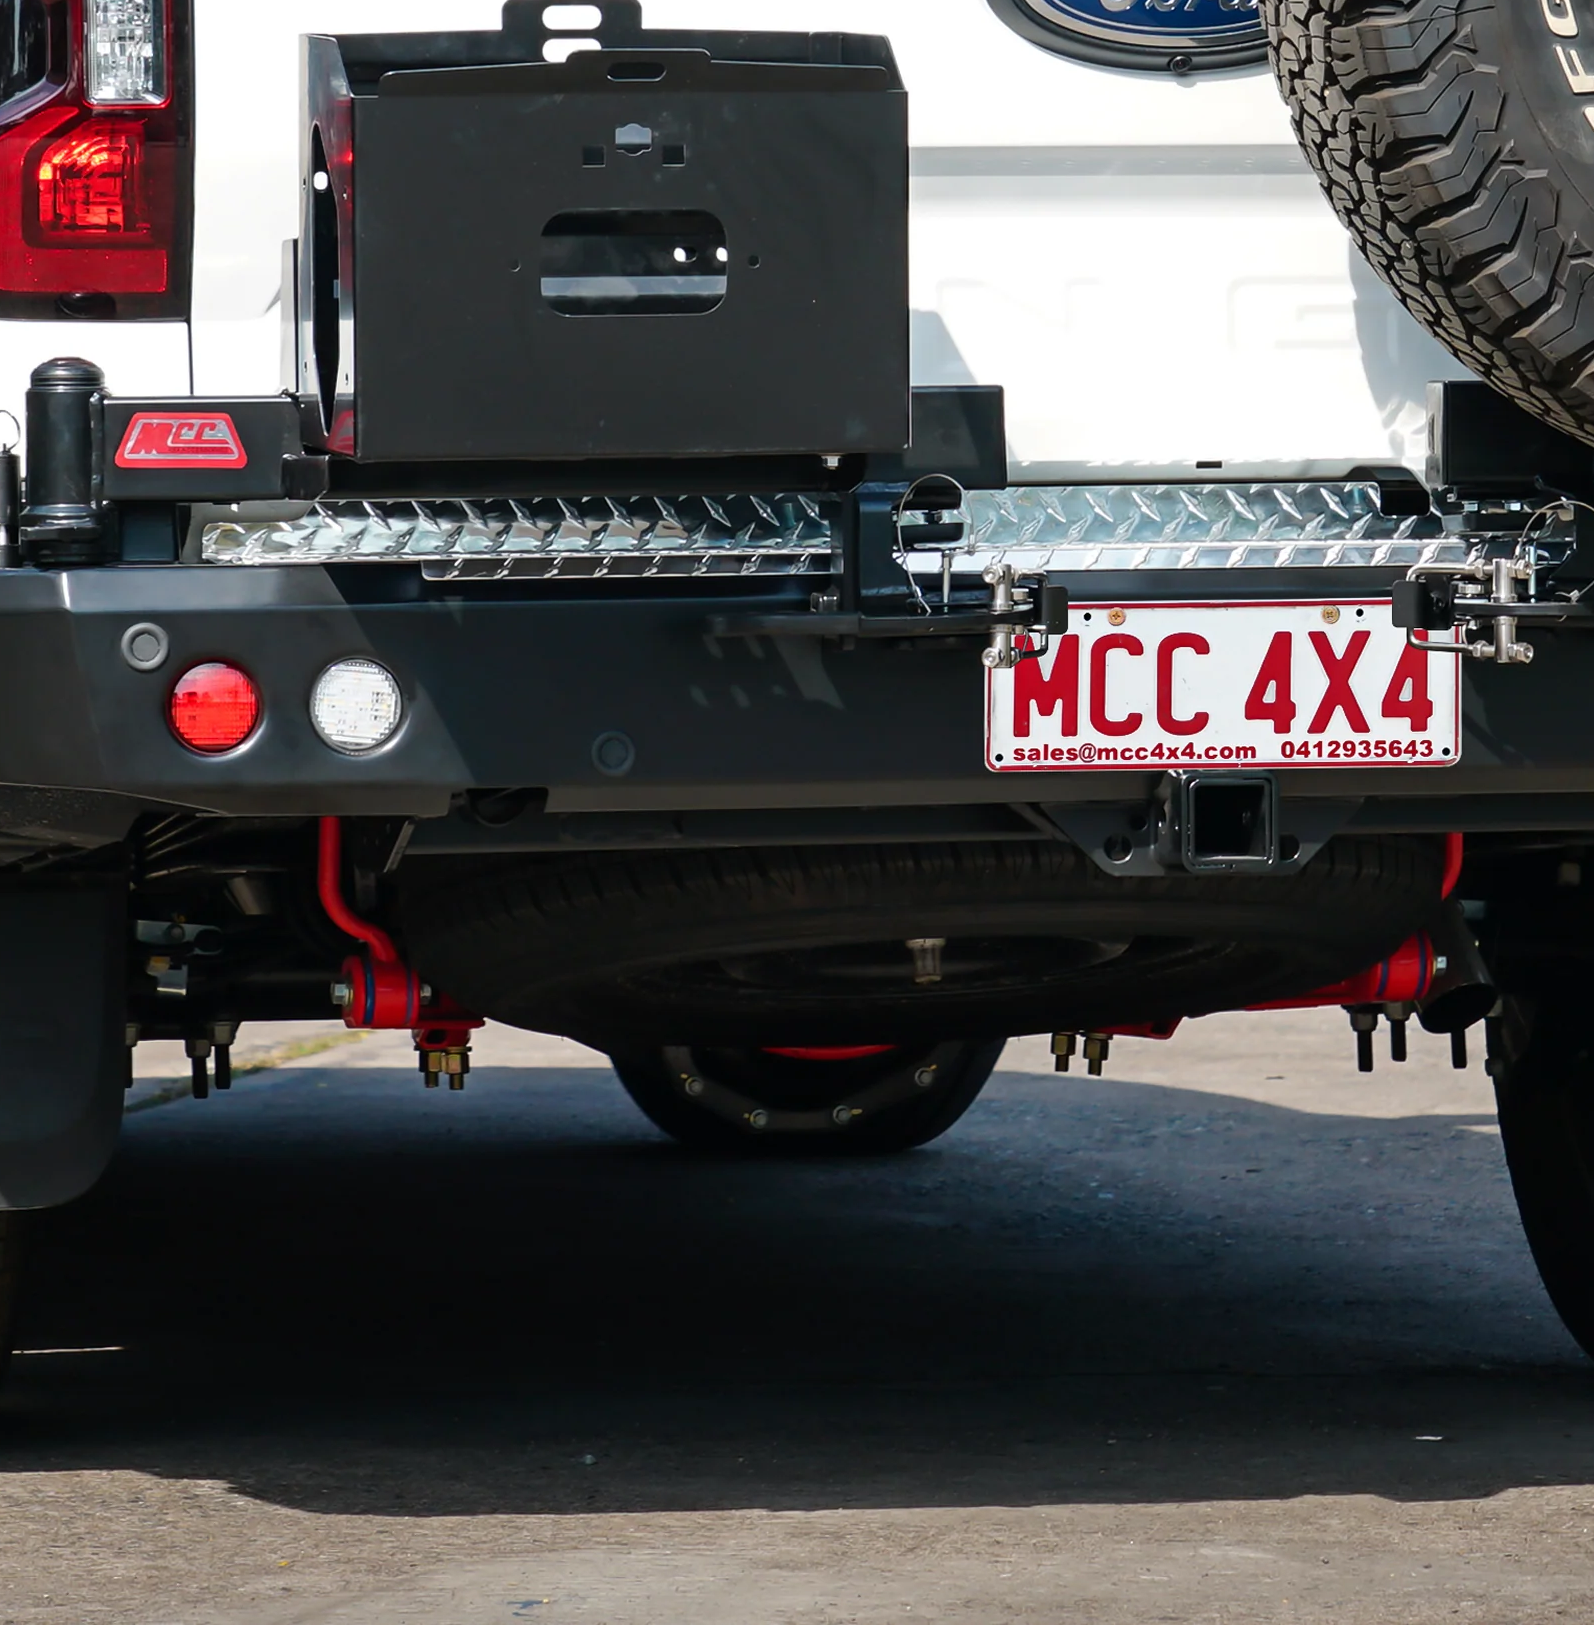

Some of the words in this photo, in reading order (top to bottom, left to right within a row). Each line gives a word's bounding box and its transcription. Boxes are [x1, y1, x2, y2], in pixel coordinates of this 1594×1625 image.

[126, 421, 232, 455] MCC
[1013, 632, 1210, 737] MCC
[1244, 630, 1434, 735] 4X4
[1013, 741, 1257, 763] sales@mcc4x4.com
[1280, 739, 1434, 758] 0412935643
